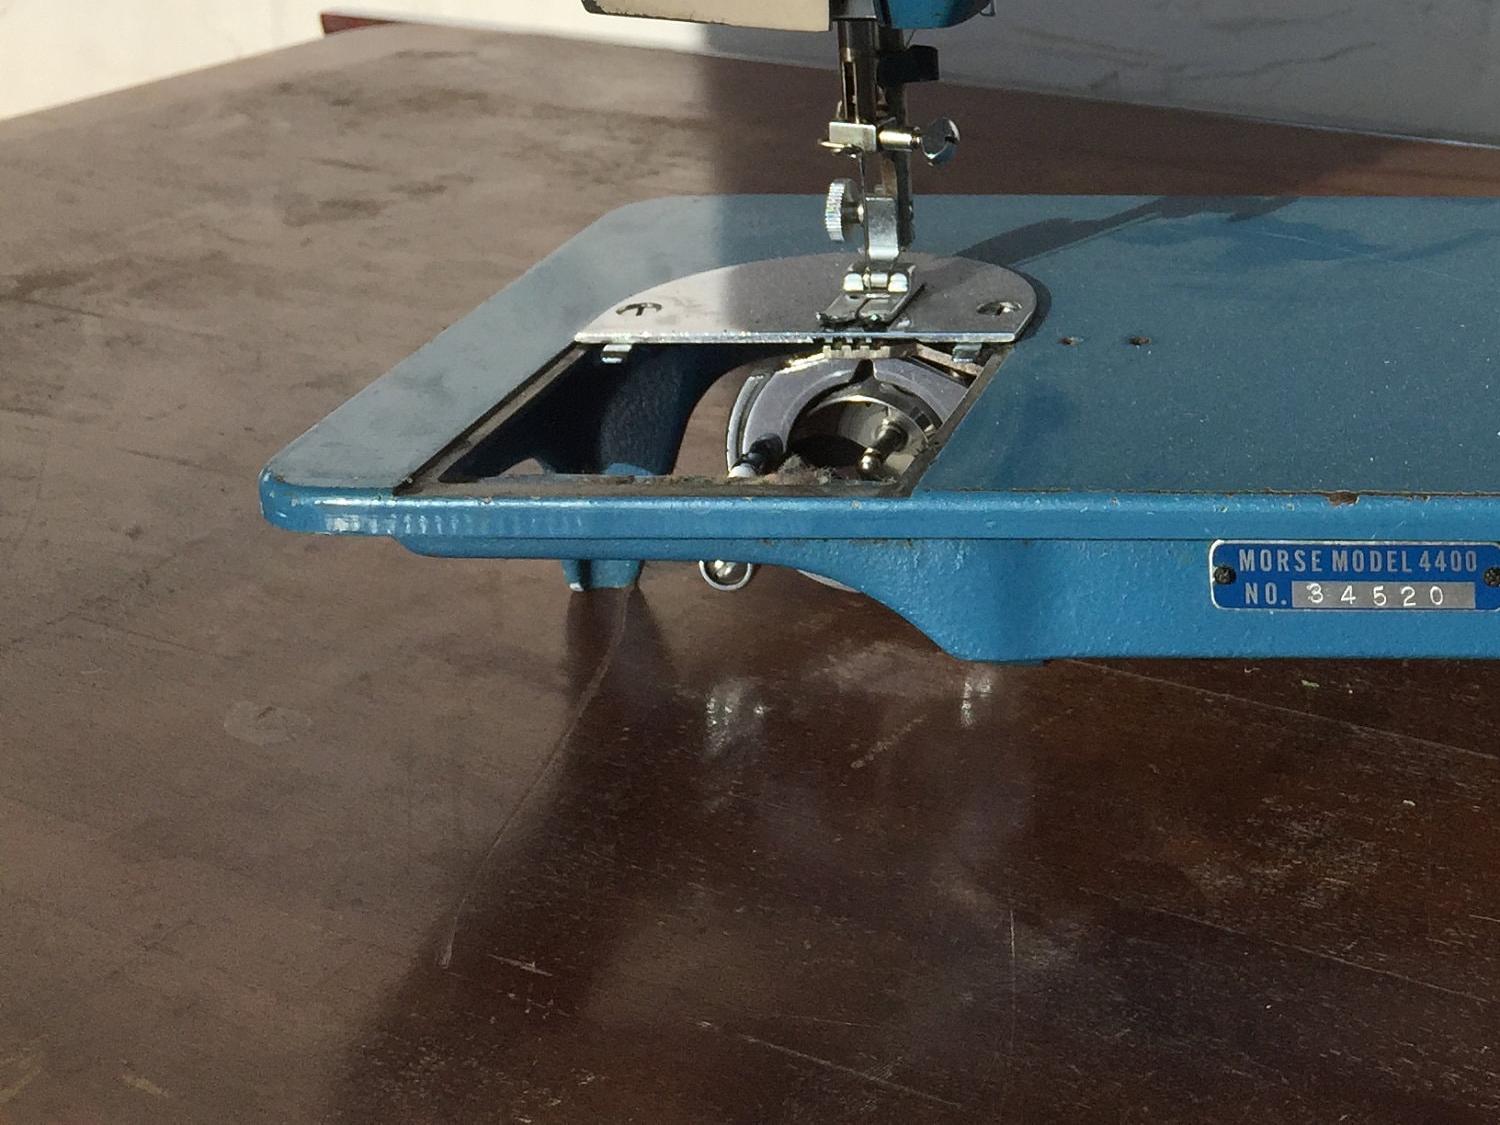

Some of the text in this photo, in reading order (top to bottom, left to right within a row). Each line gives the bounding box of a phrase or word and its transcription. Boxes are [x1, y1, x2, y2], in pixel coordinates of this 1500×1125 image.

[1239, 549, 1478, 574] MORSE MODEL 4400
[1245, 582, 1445, 607] NO. 34520
